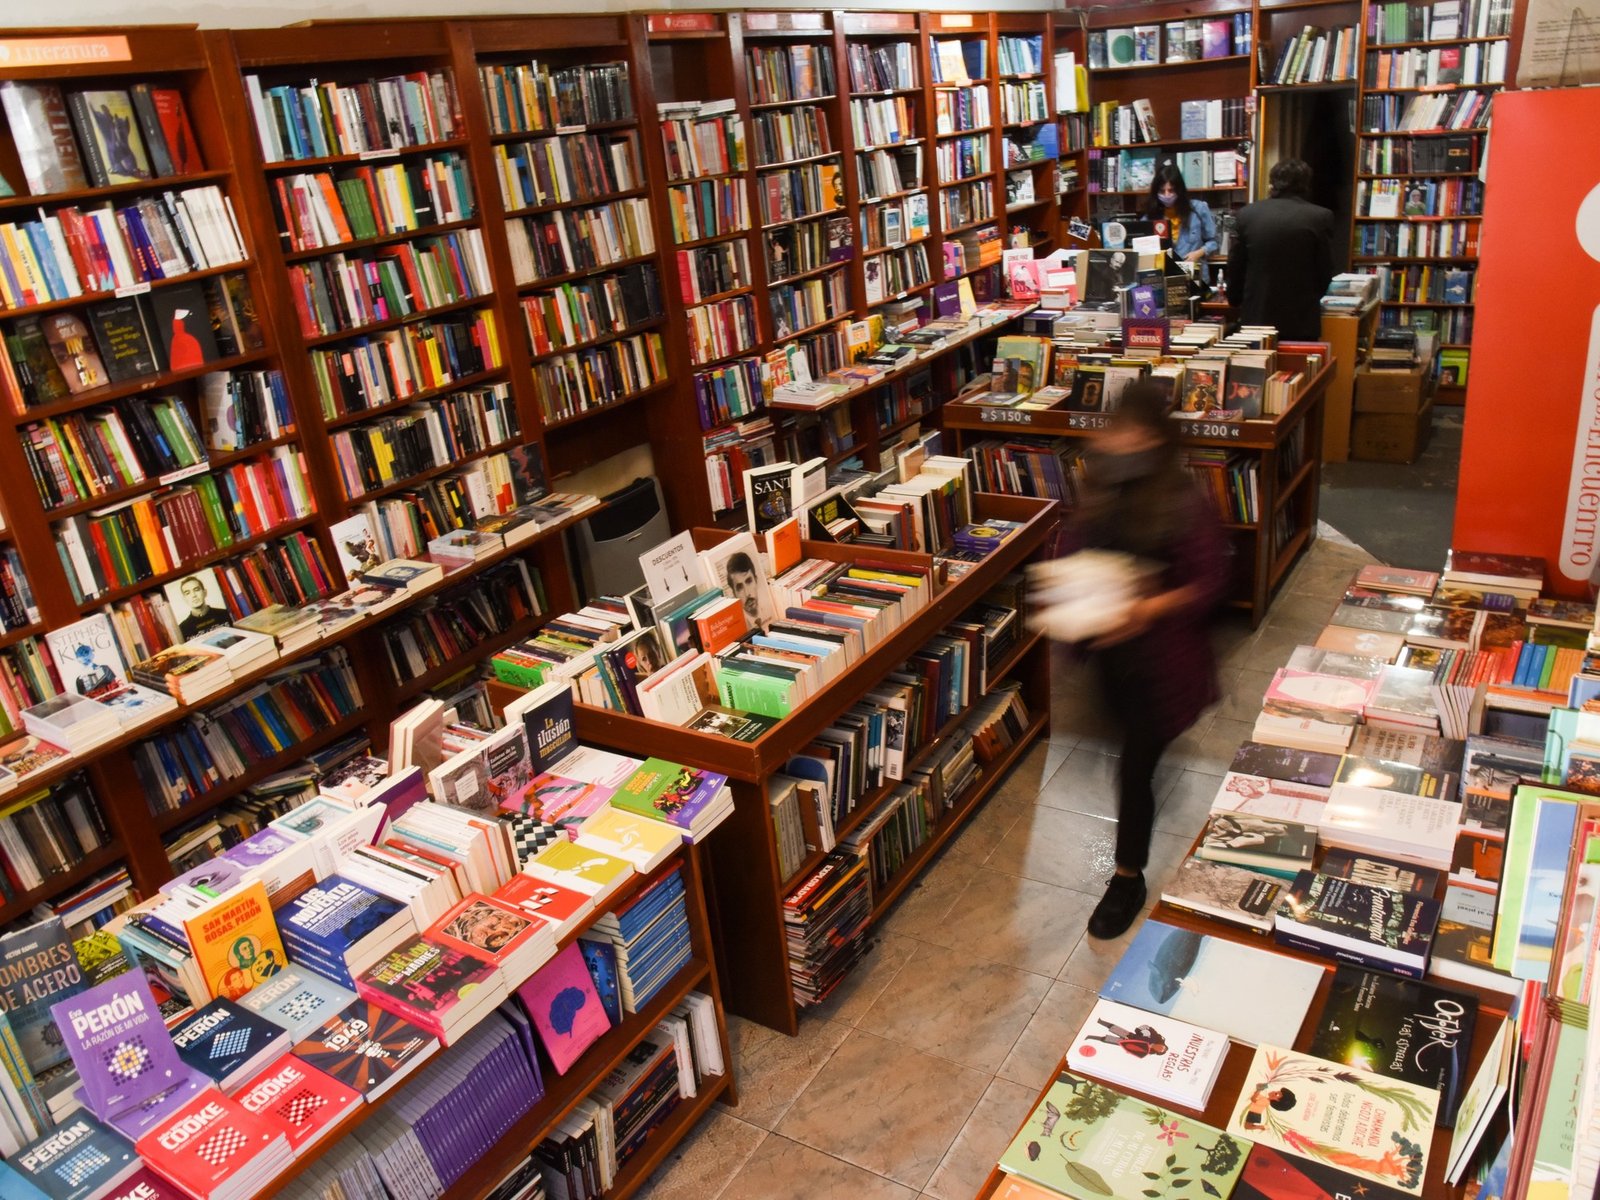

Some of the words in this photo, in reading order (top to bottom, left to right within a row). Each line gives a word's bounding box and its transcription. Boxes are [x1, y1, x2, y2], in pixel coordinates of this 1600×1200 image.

[1130, 335, 1160, 344] OFERTAS
[1001, 411, 1022, 422] 150
[1203, 425, 1227, 436] 200
[753, 476, 792, 494] SANT
[651, 543, 683, 565] DESCUENTOS
[52, 620, 105, 648] STEPHEN
[537, 717, 571, 748] ilusión
[289, 882, 355, 926] NOVENTA
[1368, 889, 1391, 942] Fantasmal
[200, 916, 222, 933] SAN
[0, 942, 72, 987] OMBRES
[400, 946, 441, 975] MADRES
[22, 963, 81, 1005] ACERO
[249, 973, 300, 1010] PERÓN
[67, 1008, 83, 1019] Eva
[70, 990, 144, 1039] PERÓN
[174, 1006, 230, 1047] PERÓN
[80, 1037, 92, 1050] LA
[89, 1026, 115, 1045] RAZÓN
[113, 1023, 124, 1035] DE
[122, 1019, 133, 1030] MI
[131, 1011, 149, 1025] VIDA
[324, 1017, 369, 1051] 1949
[1160, 1052, 1179, 1081] REGLAS!
[241, 1065, 301, 1111] COOKE
[159, 1100, 224, 1151] COOKE
[1357, 1100, 1373, 1121] NGOZI
[1351, 1121, 1368, 1148] ADICHIE
[1367, 1108, 1385, 1147] CHIMAMANDA
[21, 1120, 90, 1171] PERÓN
